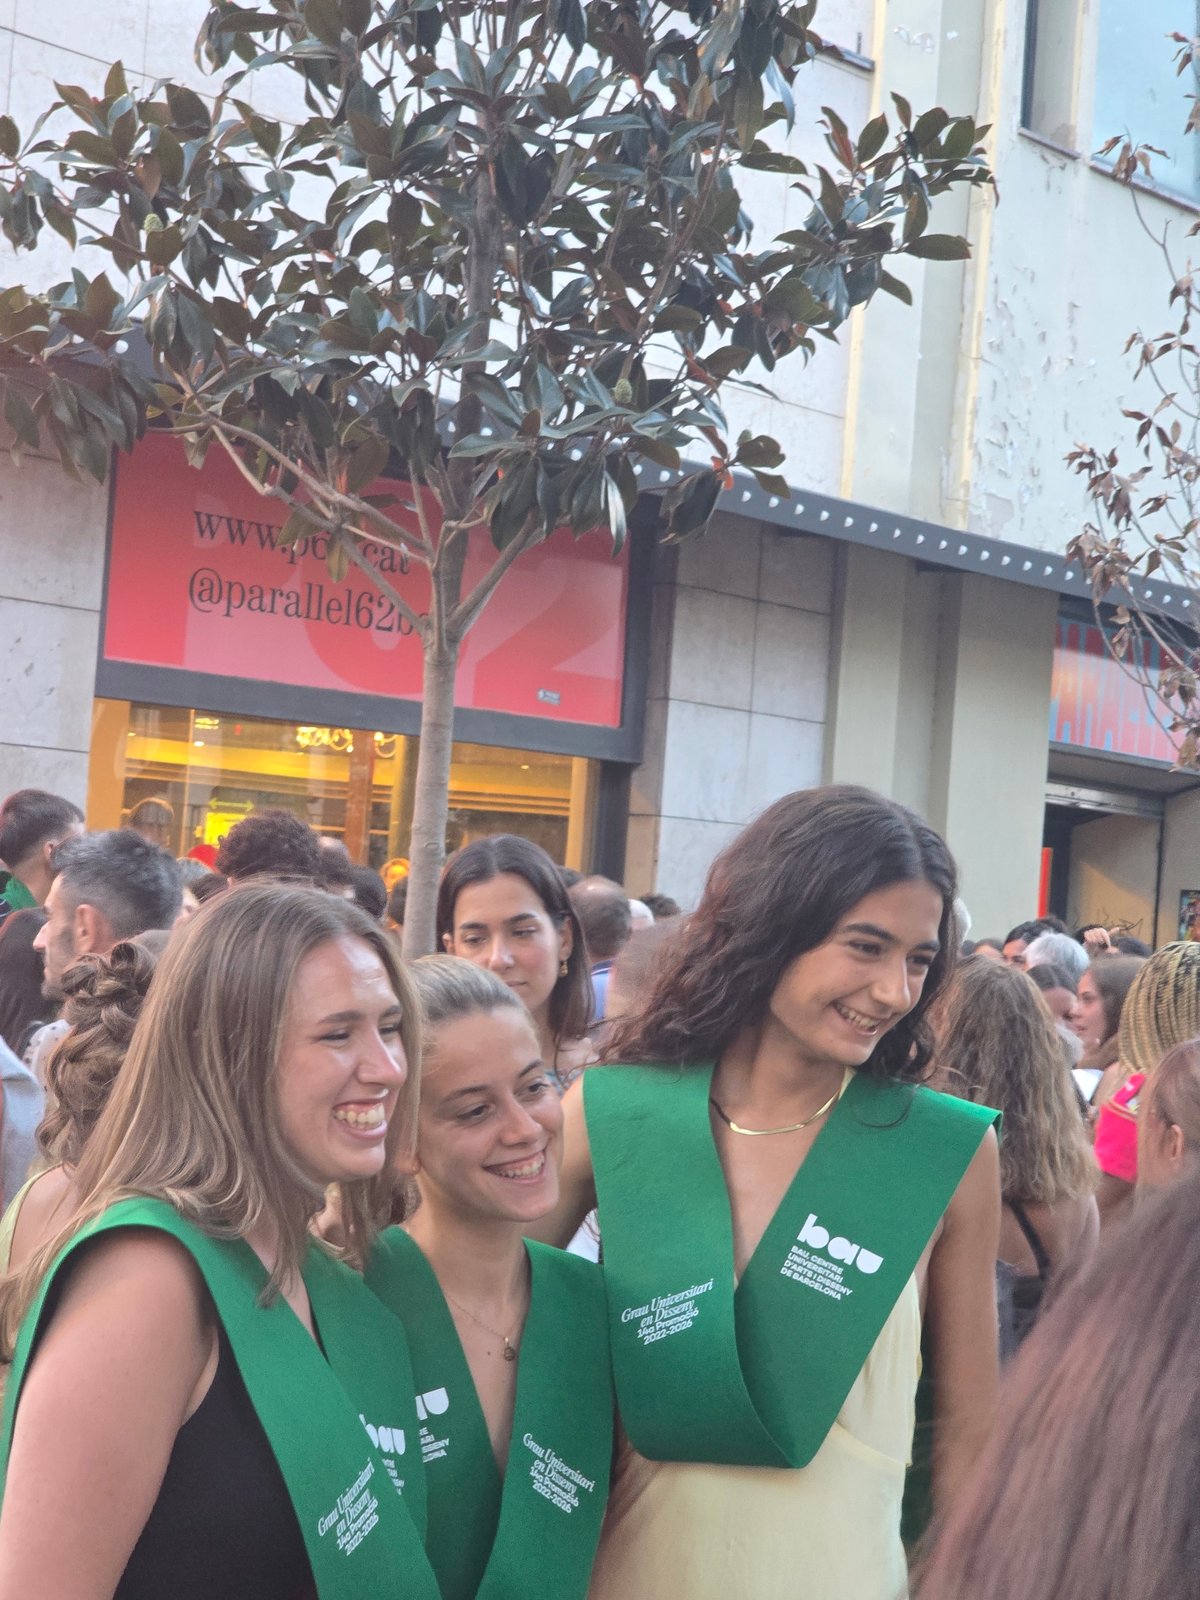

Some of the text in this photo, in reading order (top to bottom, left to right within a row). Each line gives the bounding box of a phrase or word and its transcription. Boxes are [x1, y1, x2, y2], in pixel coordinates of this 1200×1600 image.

[797, 1213, 884, 1275] bau
[787, 1252, 844, 1283] UNIVERSITARI
[790, 1245, 844, 1275] BAU, CENTRE
[780, 1267, 842, 1301] DE BARCELONA
[783, 1259, 813, 1277] D'ARTS
[816, 1275, 854, 1296] DISSENY
[621, 1278, 714, 1323] Grau Universitari
[640, 1299, 695, 1328] en Disseny
[643, 1319, 693, 1346] 2022-2026
[655, 1306, 699, 1331] Promoció
[523, 1432, 596, 1492] Grau Universitari
[533, 1459, 578, 1495] en Disseny
[532, 1479, 572, 1513] 2022-2026
[543, 1476, 579, 1507] Promoció
[318, 1507, 339, 1537] Grau
[336, 1518, 347, 1537] en
